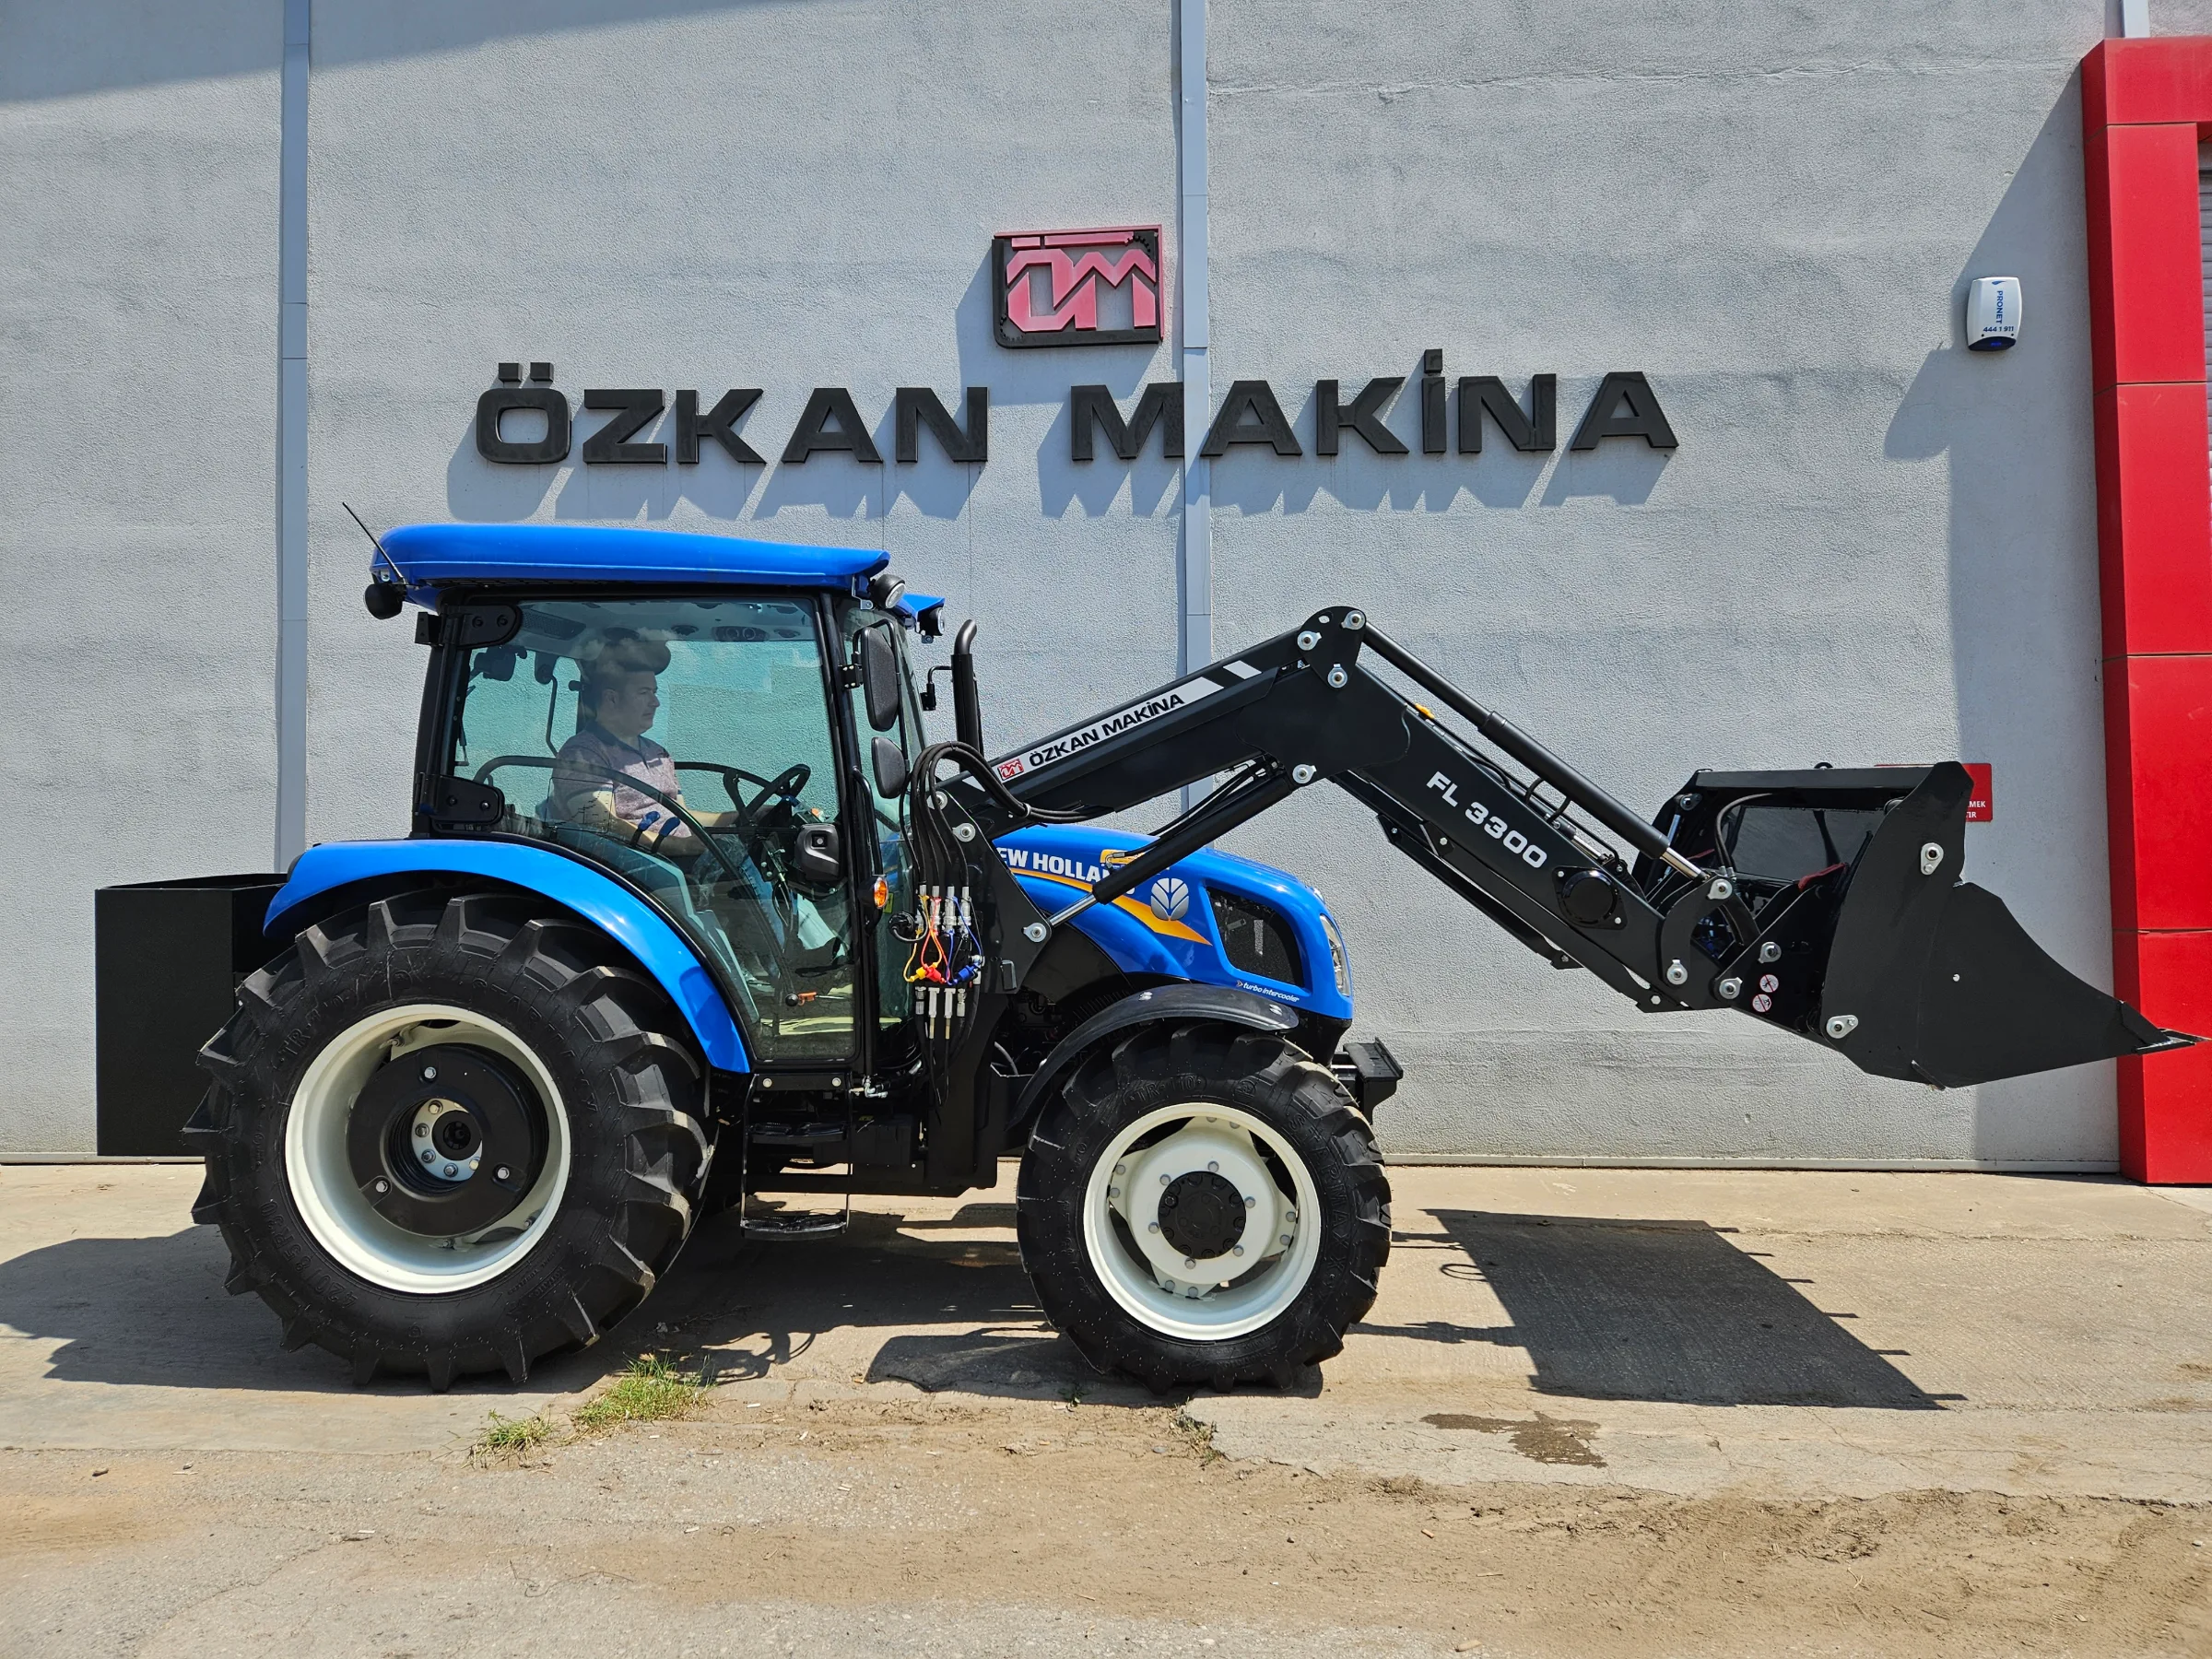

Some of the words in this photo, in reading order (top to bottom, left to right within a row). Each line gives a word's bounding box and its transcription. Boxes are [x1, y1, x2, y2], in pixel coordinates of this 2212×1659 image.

[1995, 290, 2004, 324] PRONET
[477, 361, 989, 465] ÖZKAN
[1070, 348, 1679, 461] MAKİNA
[1029, 728, 1100, 767] ÖZKAN
[1102, 693, 1185, 736] MAKİNA
[1426, 771, 1459, 807] FL
[1465, 801, 1547, 868] 3300
[1032, 853, 1135, 895] HOLLA
[1242, 982, 1263, 993] turbo
[1262, 987, 1300, 1003] intercooler
